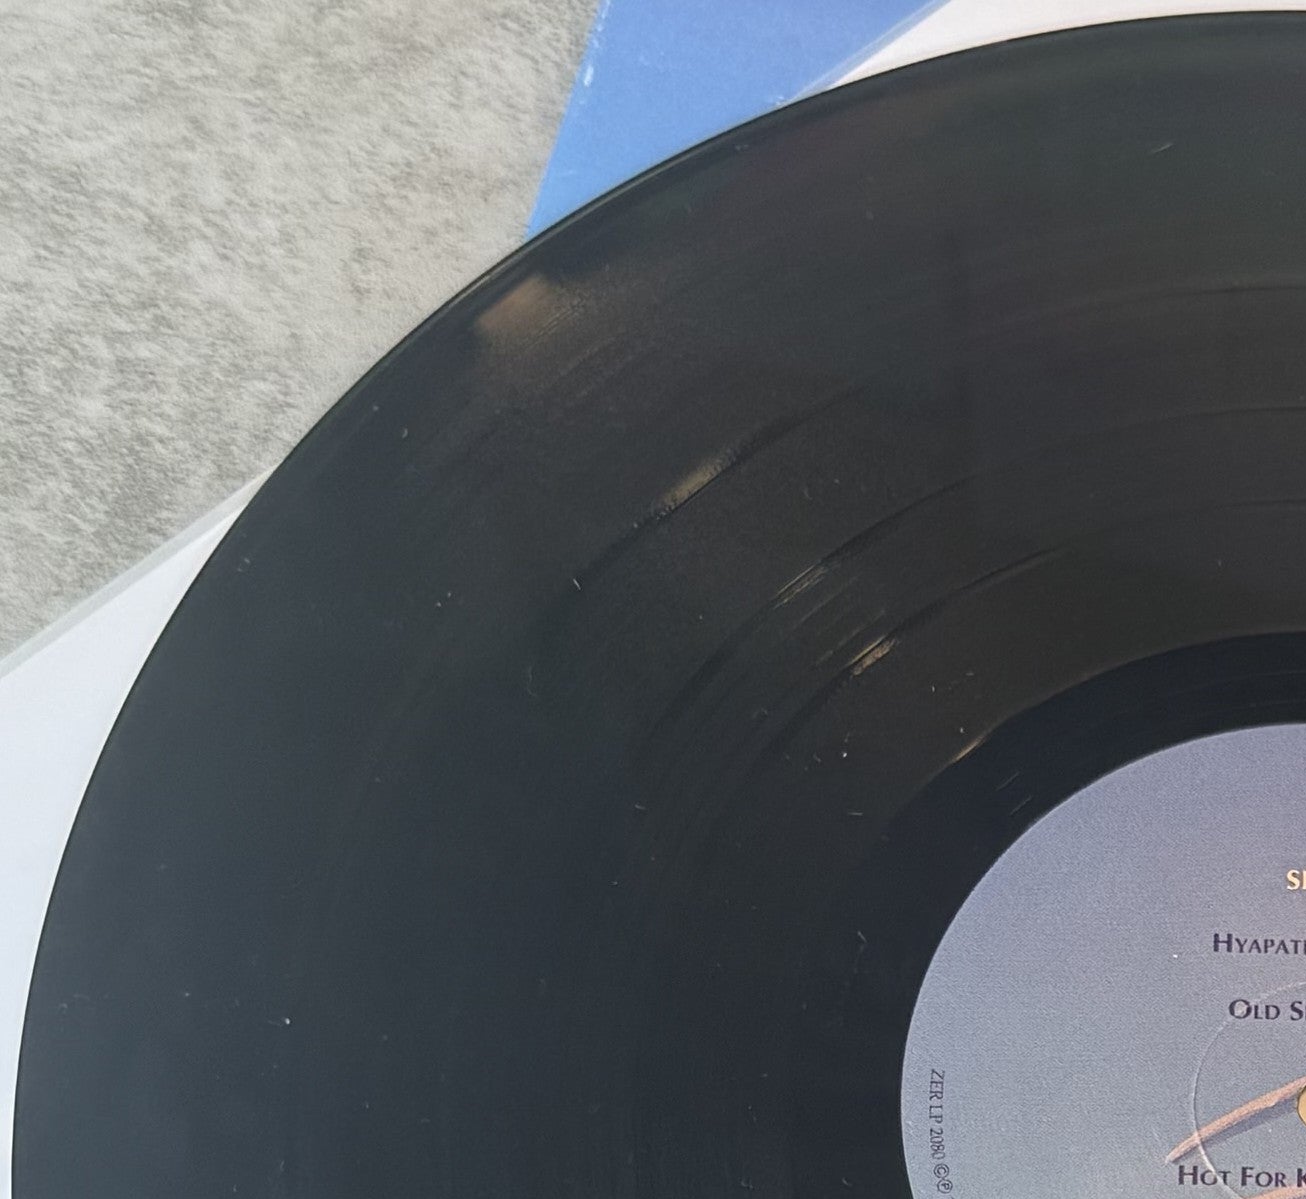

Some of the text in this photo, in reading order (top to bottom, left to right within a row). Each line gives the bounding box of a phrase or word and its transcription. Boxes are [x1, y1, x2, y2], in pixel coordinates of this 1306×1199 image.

[1228, 999, 1280, 1021] OLD
[930, 1128, 946, 1160] 2080
[1178, 1165, 1231, 1187] HOT
[1240, 1167, 1287, 1188] FOR
